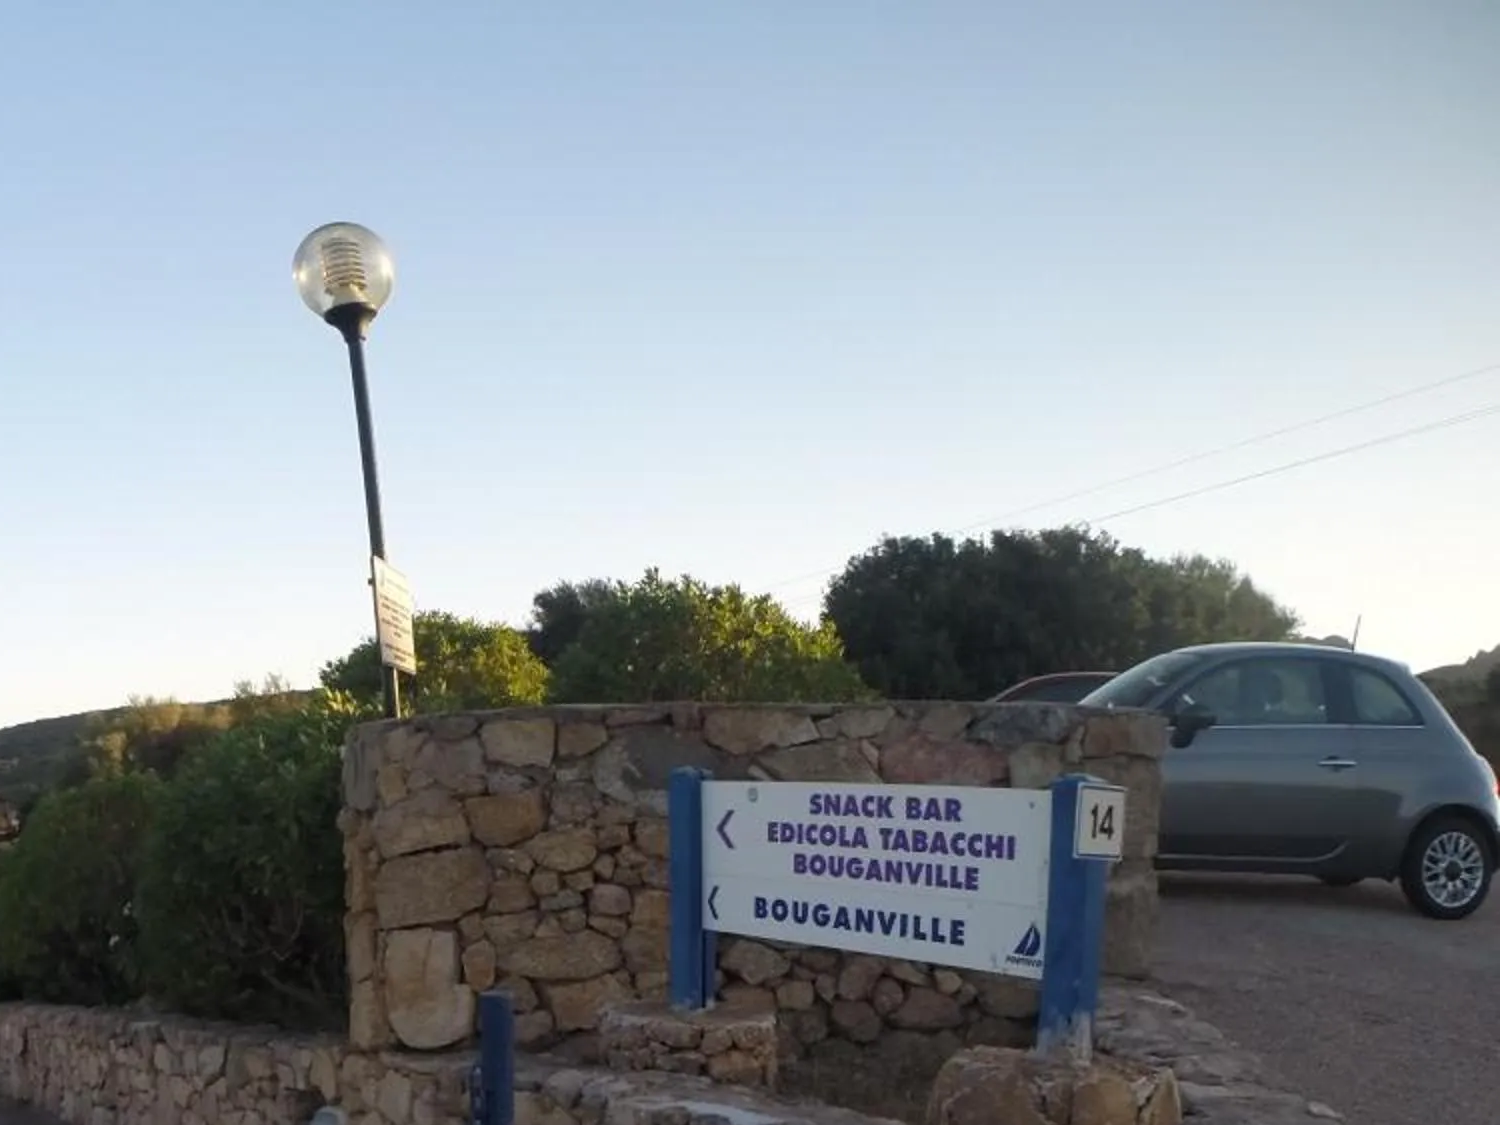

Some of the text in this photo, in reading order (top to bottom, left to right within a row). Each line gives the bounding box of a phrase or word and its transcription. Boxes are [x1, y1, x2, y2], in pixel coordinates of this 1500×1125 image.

[809, 793, 962, 822] SNACK BAR
[1091, 803, 1114, 840] 14
[767, 822, 1016, 860] EDICOLA TABACCHI
[793, 853, 979, 891] BOUGANVILLE
[754, 896, 966, 946] BOUGANVILLE
